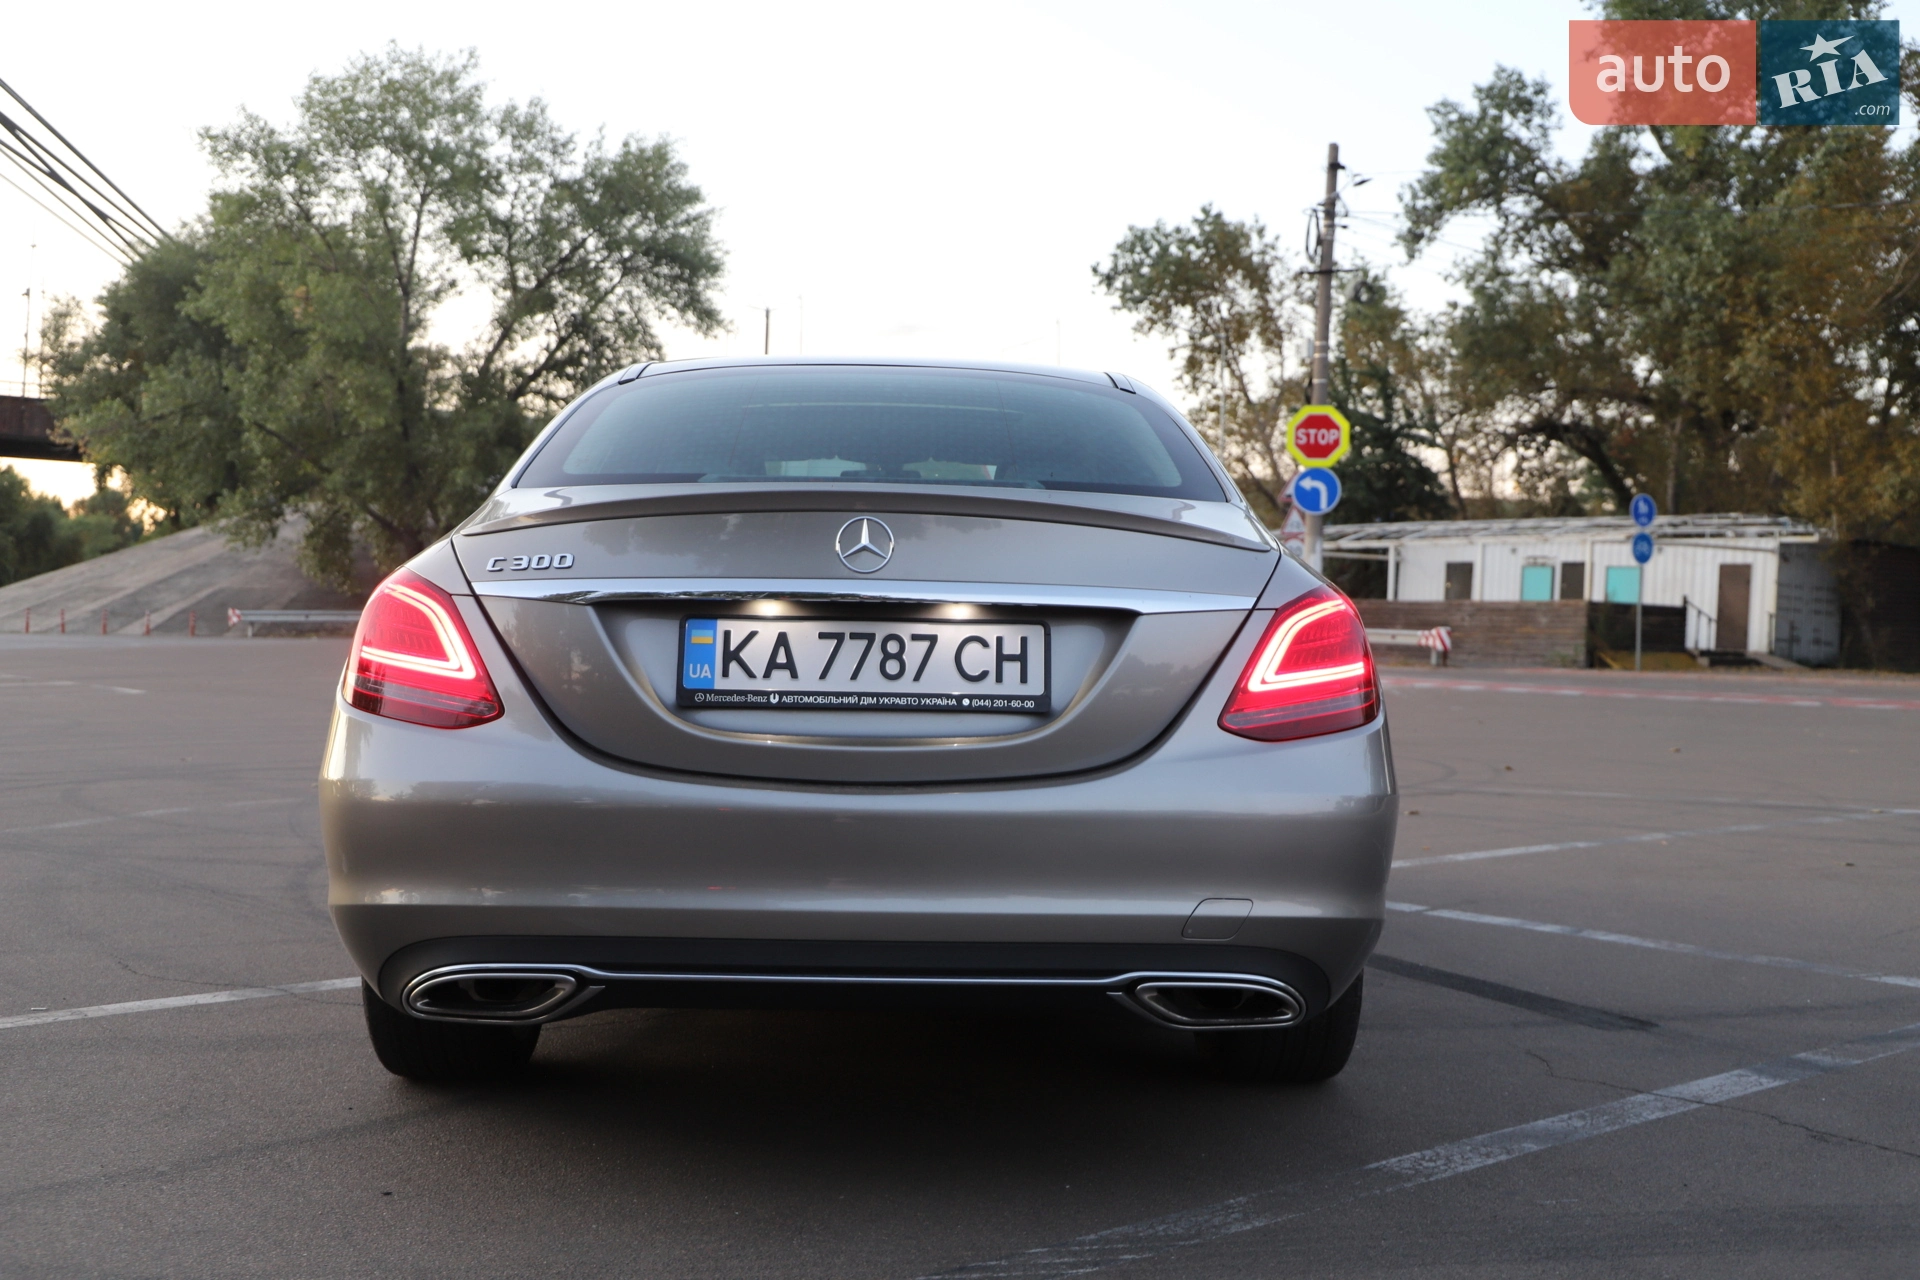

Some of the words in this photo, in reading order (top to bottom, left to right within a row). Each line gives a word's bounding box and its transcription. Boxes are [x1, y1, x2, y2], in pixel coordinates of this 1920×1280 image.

[1296, 428, 1340, 446] STOP
[721, 629, 799, 679] KA
[818, 631, 938, 682] 7787
[954, 635, 1028, 684] CH
[689, 663, 712, 679] UA
[706, 693, 768, 703] Mercedes-Benz
[781, 694, 859, 704] АВТОМОБІЛЬНИЙ
[860, 696, 877, 705] ДІМ
[878, 696, 919, 705] УКРАВТО
[920, 696, 957, 706] УКРАЇНА
[971, 699, 992, 707] (044)
[993, 699, 1035, 708] 201-60-00
